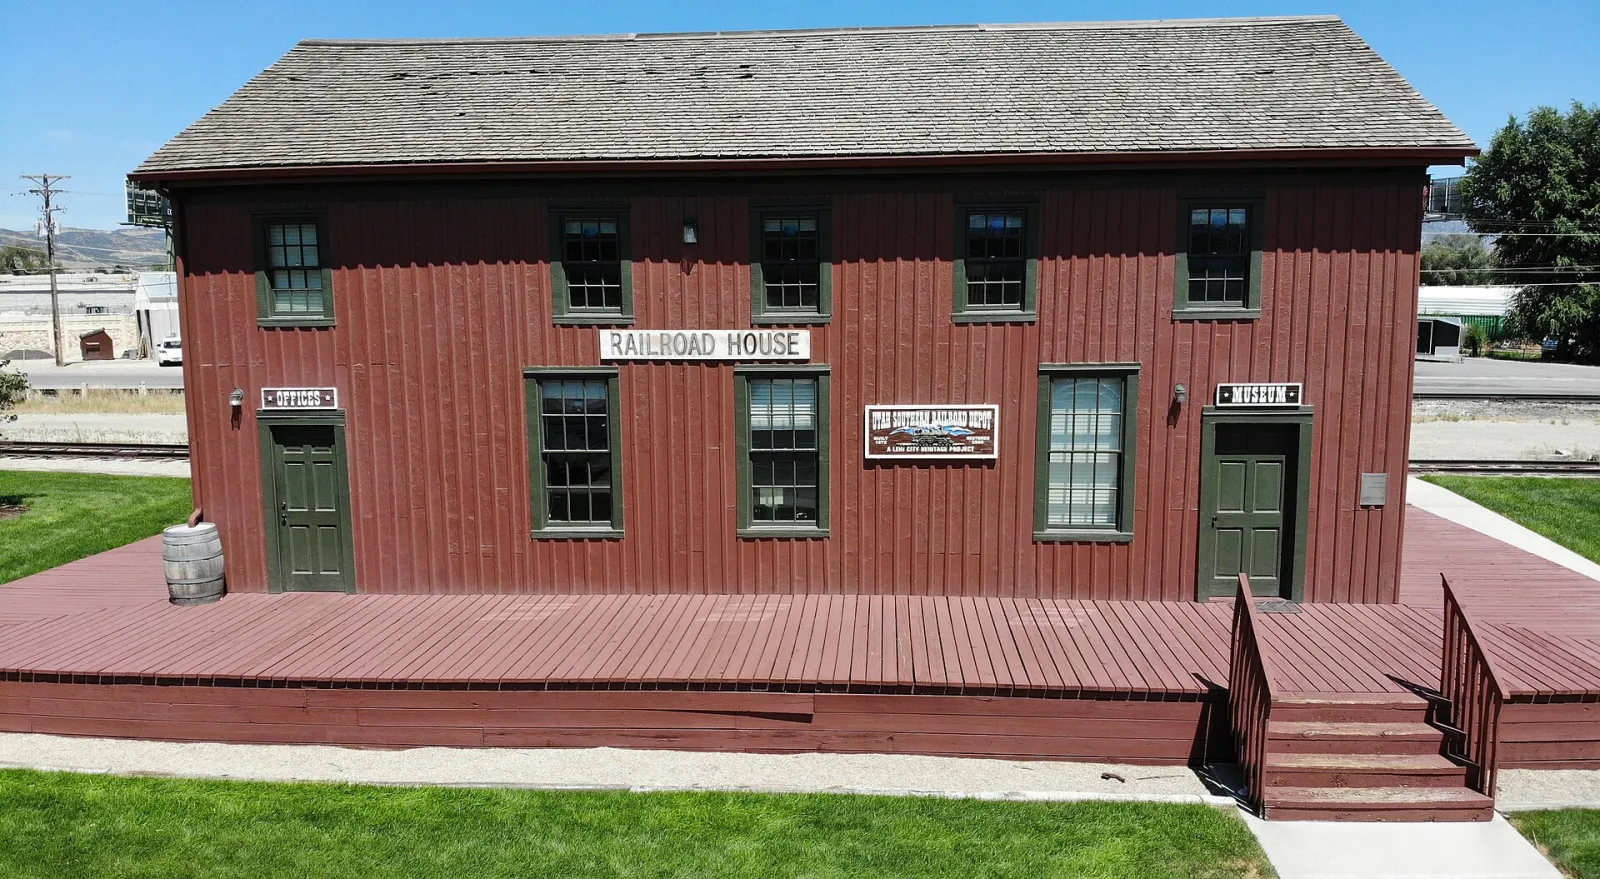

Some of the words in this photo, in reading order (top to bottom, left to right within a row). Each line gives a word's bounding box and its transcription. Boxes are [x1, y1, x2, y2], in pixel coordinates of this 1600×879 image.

[610, 332, 715, 356] RAILROAD
[727, 332, 800, 356] HOUSE
[276, 390, 321, 406] OFFICES
[1231, 386, 1287, 403] MUSEUM
[872, 411, 891, 430] UTAH
[892, 411, 930, 428] SOUTHERN
[931, 411, 967, 427] RAILROAD
[968, 411, 992, 430] DEPOT
